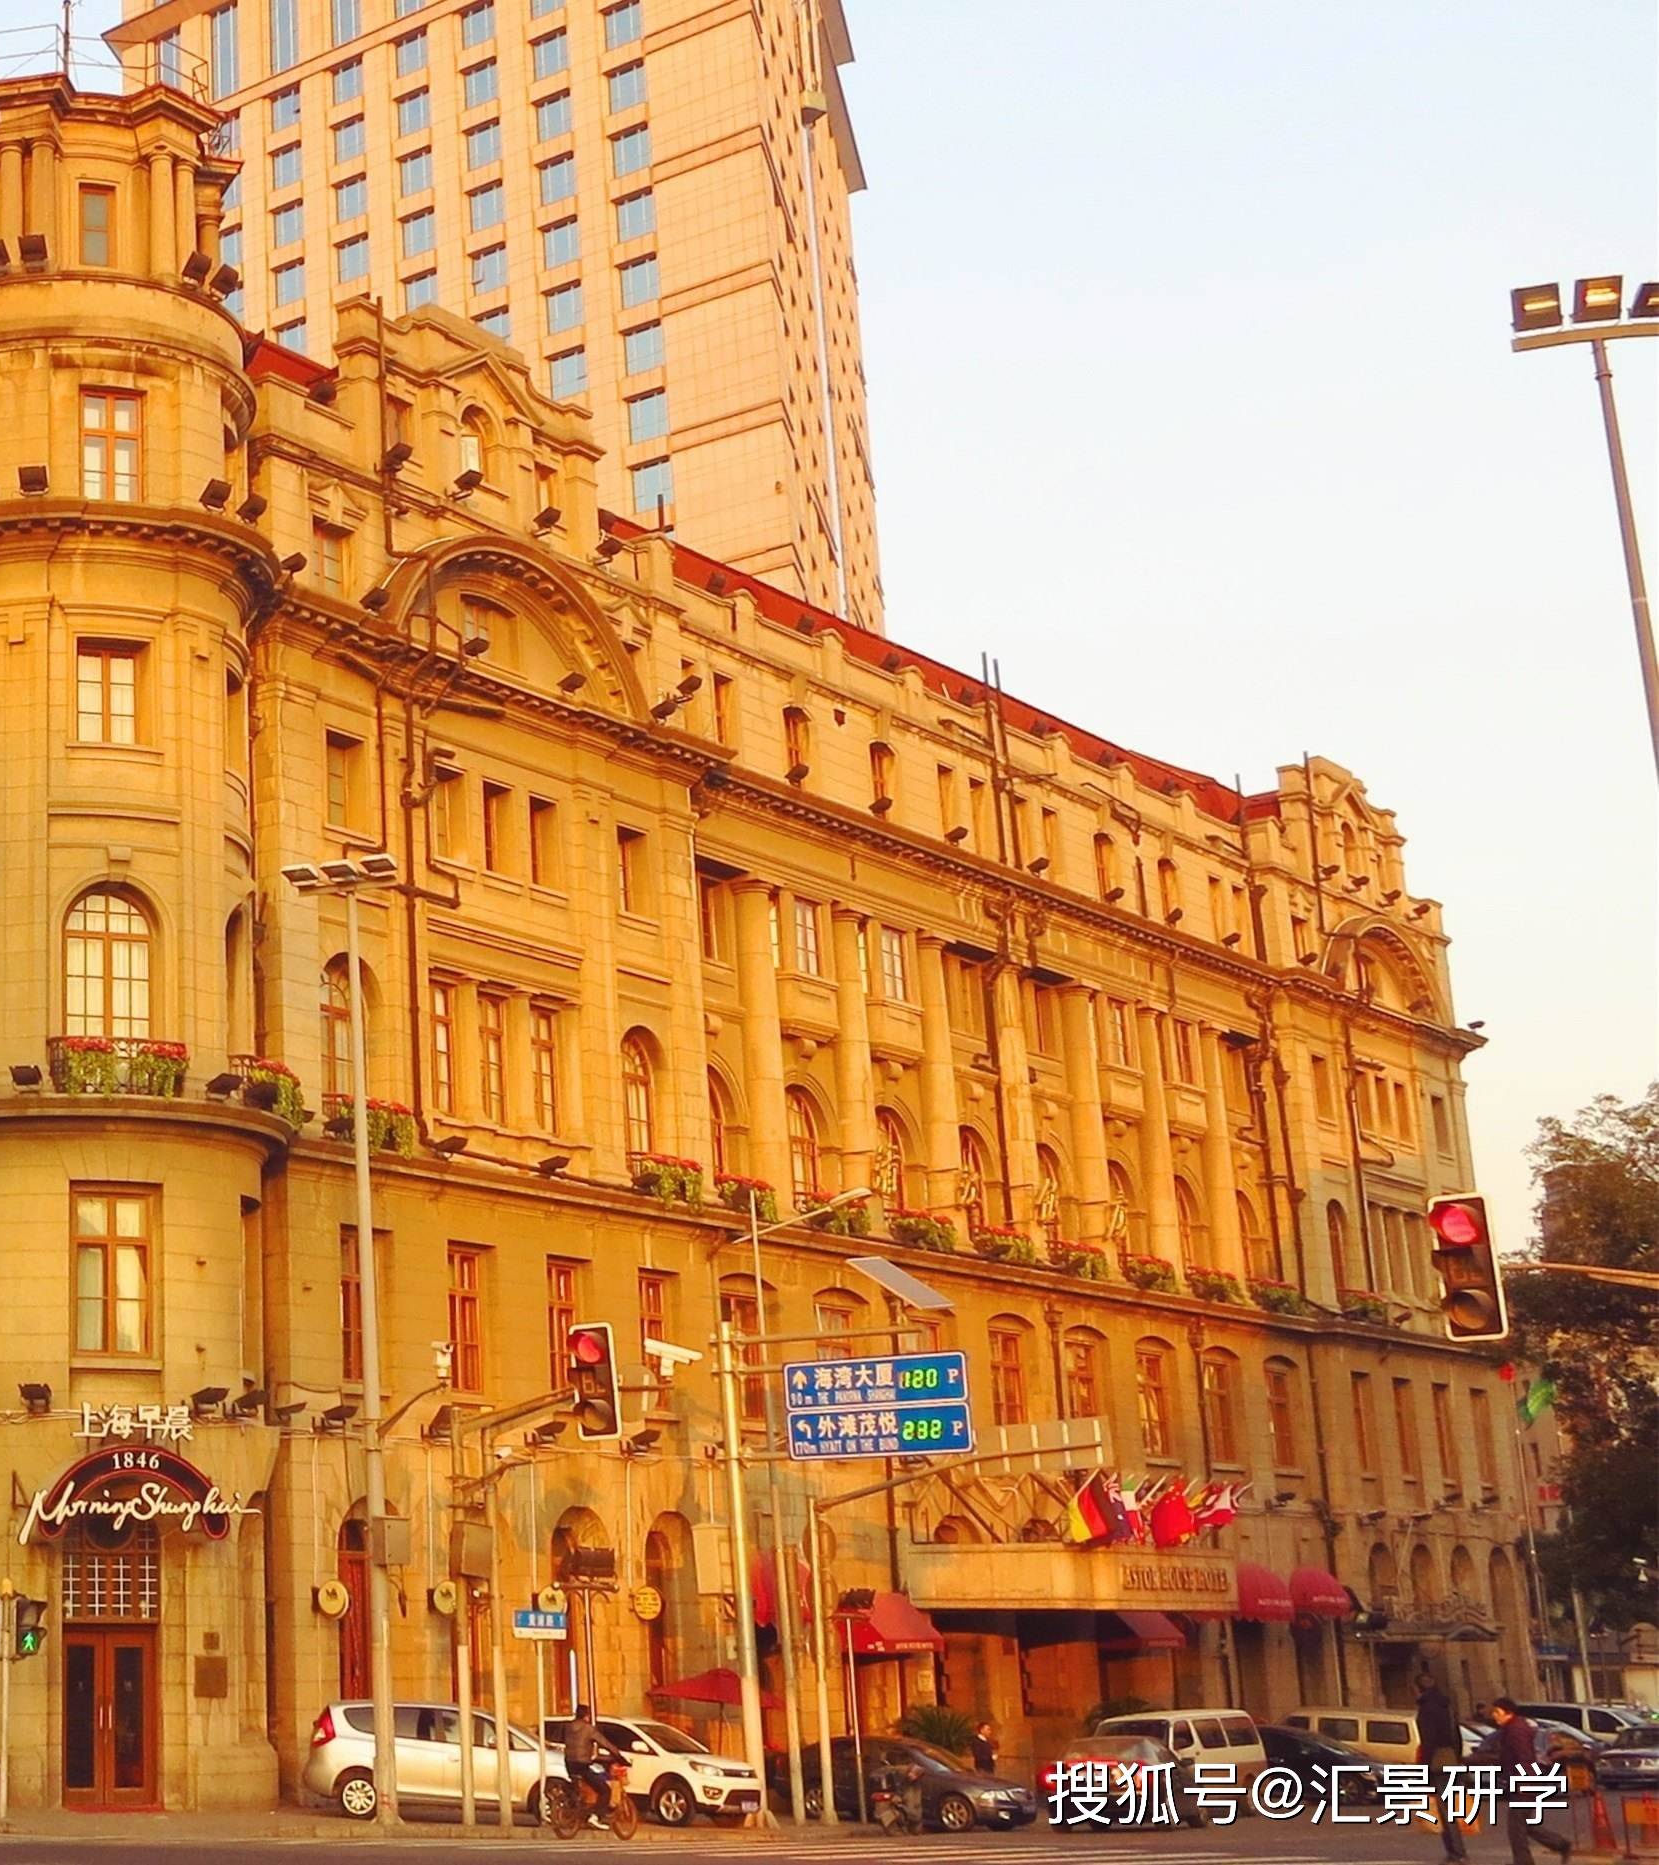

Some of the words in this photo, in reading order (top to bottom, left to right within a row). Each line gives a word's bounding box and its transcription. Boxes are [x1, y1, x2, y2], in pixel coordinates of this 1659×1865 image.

[814, 1363, 894, 1390] 海湾大厦
[948, 1368, 959, 1384] P
[72, 1402, 194, 1441] 上海早晨
[817, 1411, 899, 1439] 外滩茂悦
[953, 1420, 963, 1436] P
[112, 1452, 160, 1470] 1846
